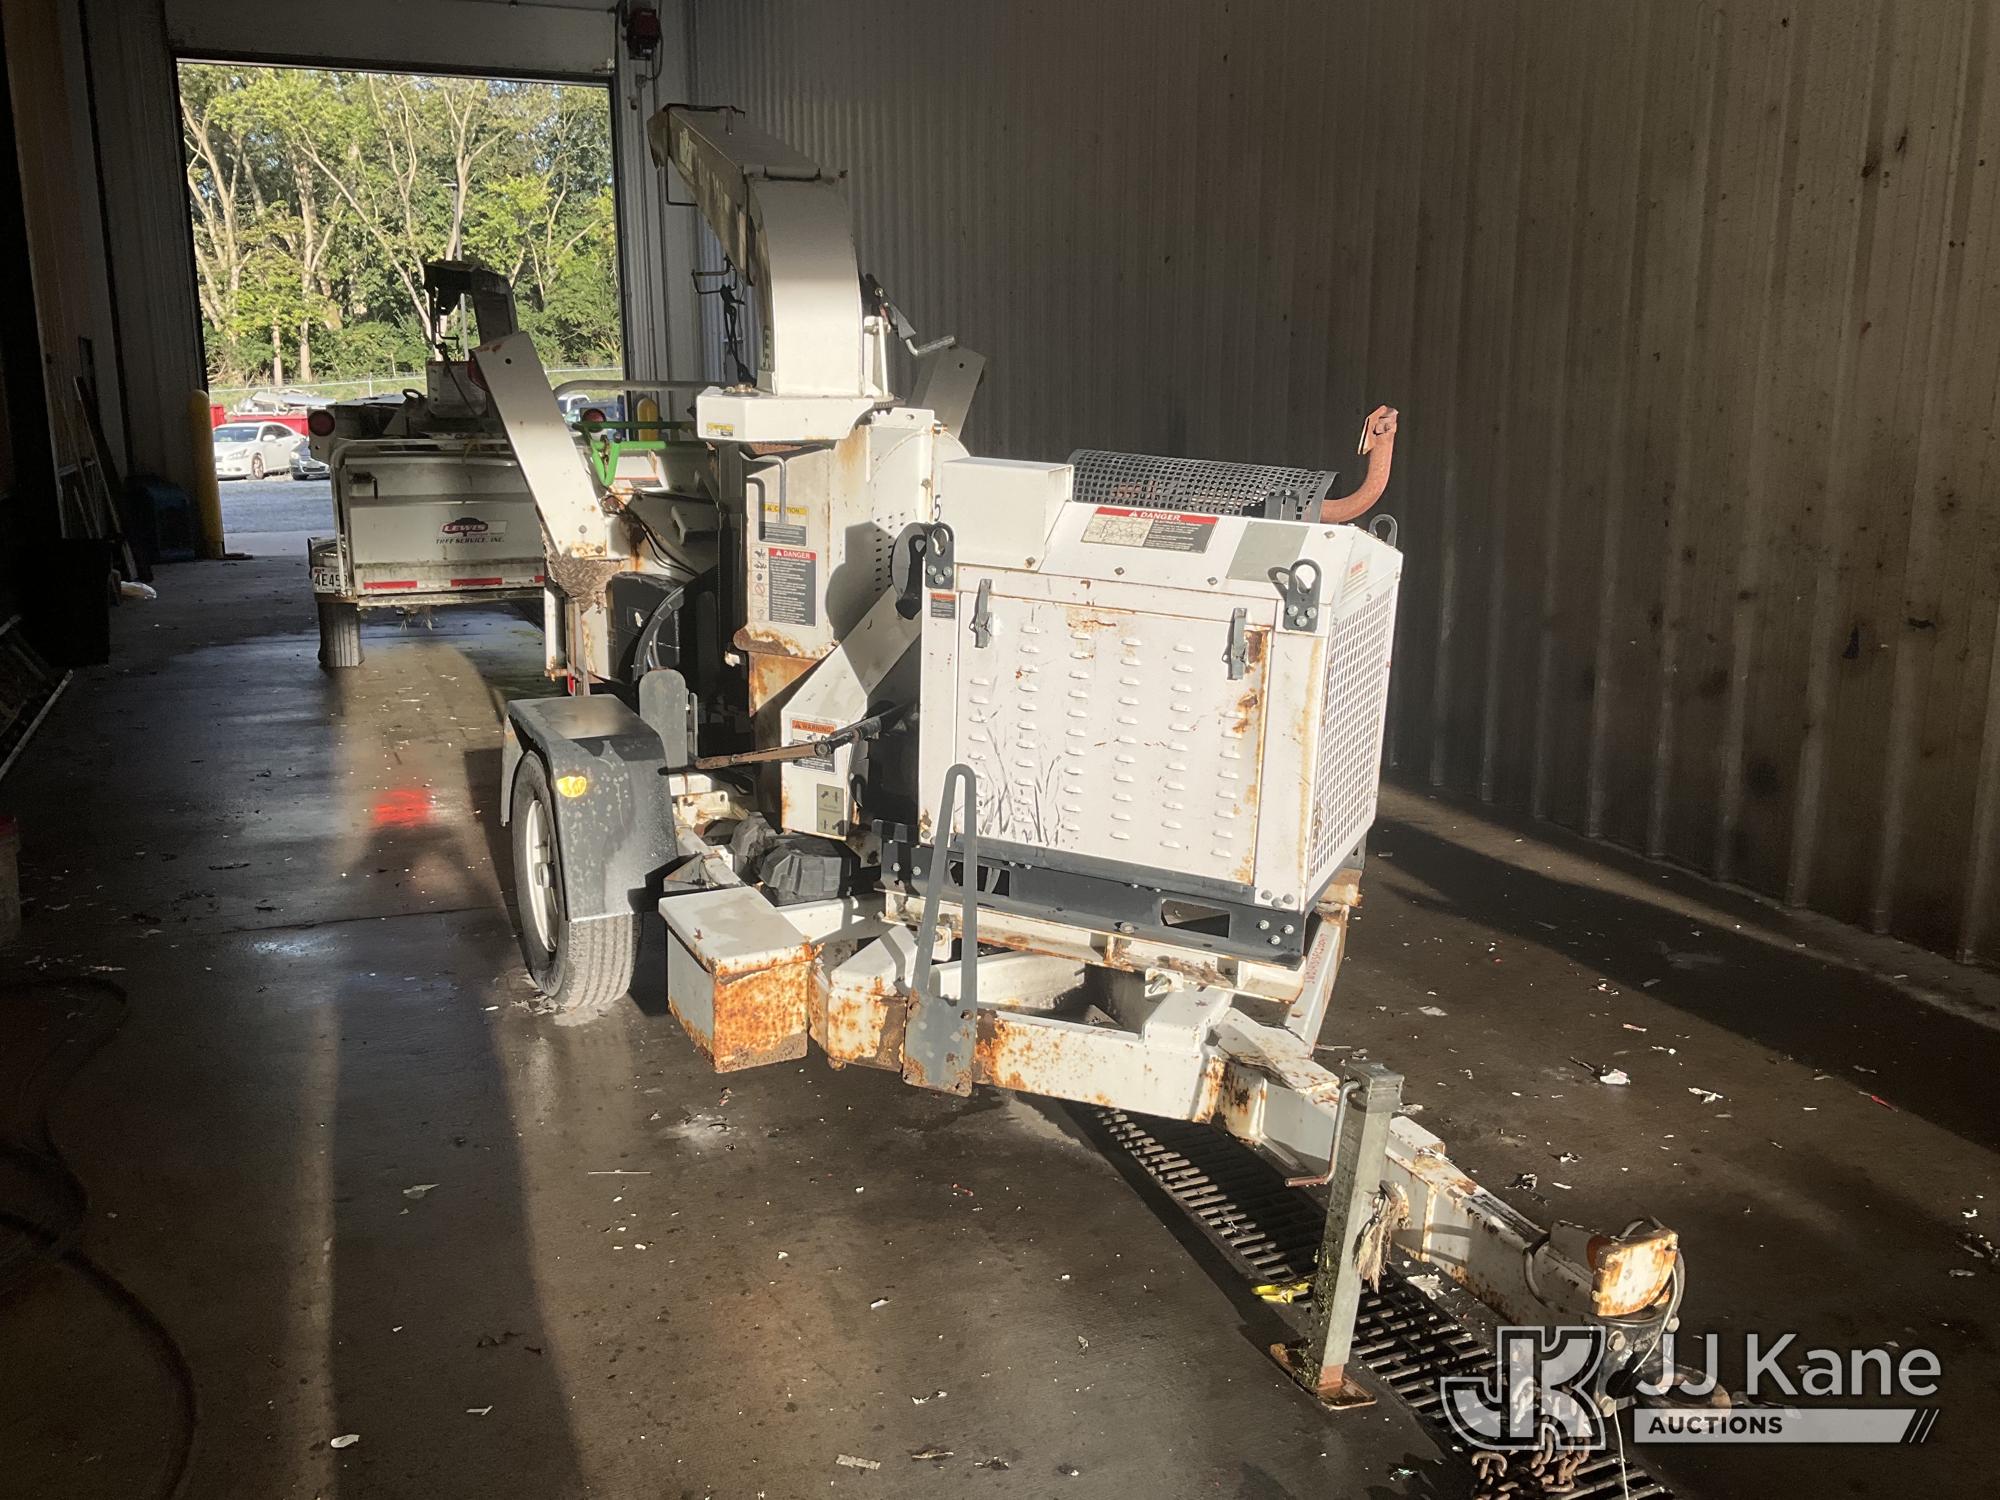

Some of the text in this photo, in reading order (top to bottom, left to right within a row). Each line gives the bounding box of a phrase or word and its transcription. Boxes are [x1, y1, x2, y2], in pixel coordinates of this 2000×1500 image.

[773, 505, 800, 514] CTION
[1140, 511, 1181, 521] DANGER
[444, 524, 486, 532] LEWIS
[783, 550, 810, 559] DANGER
